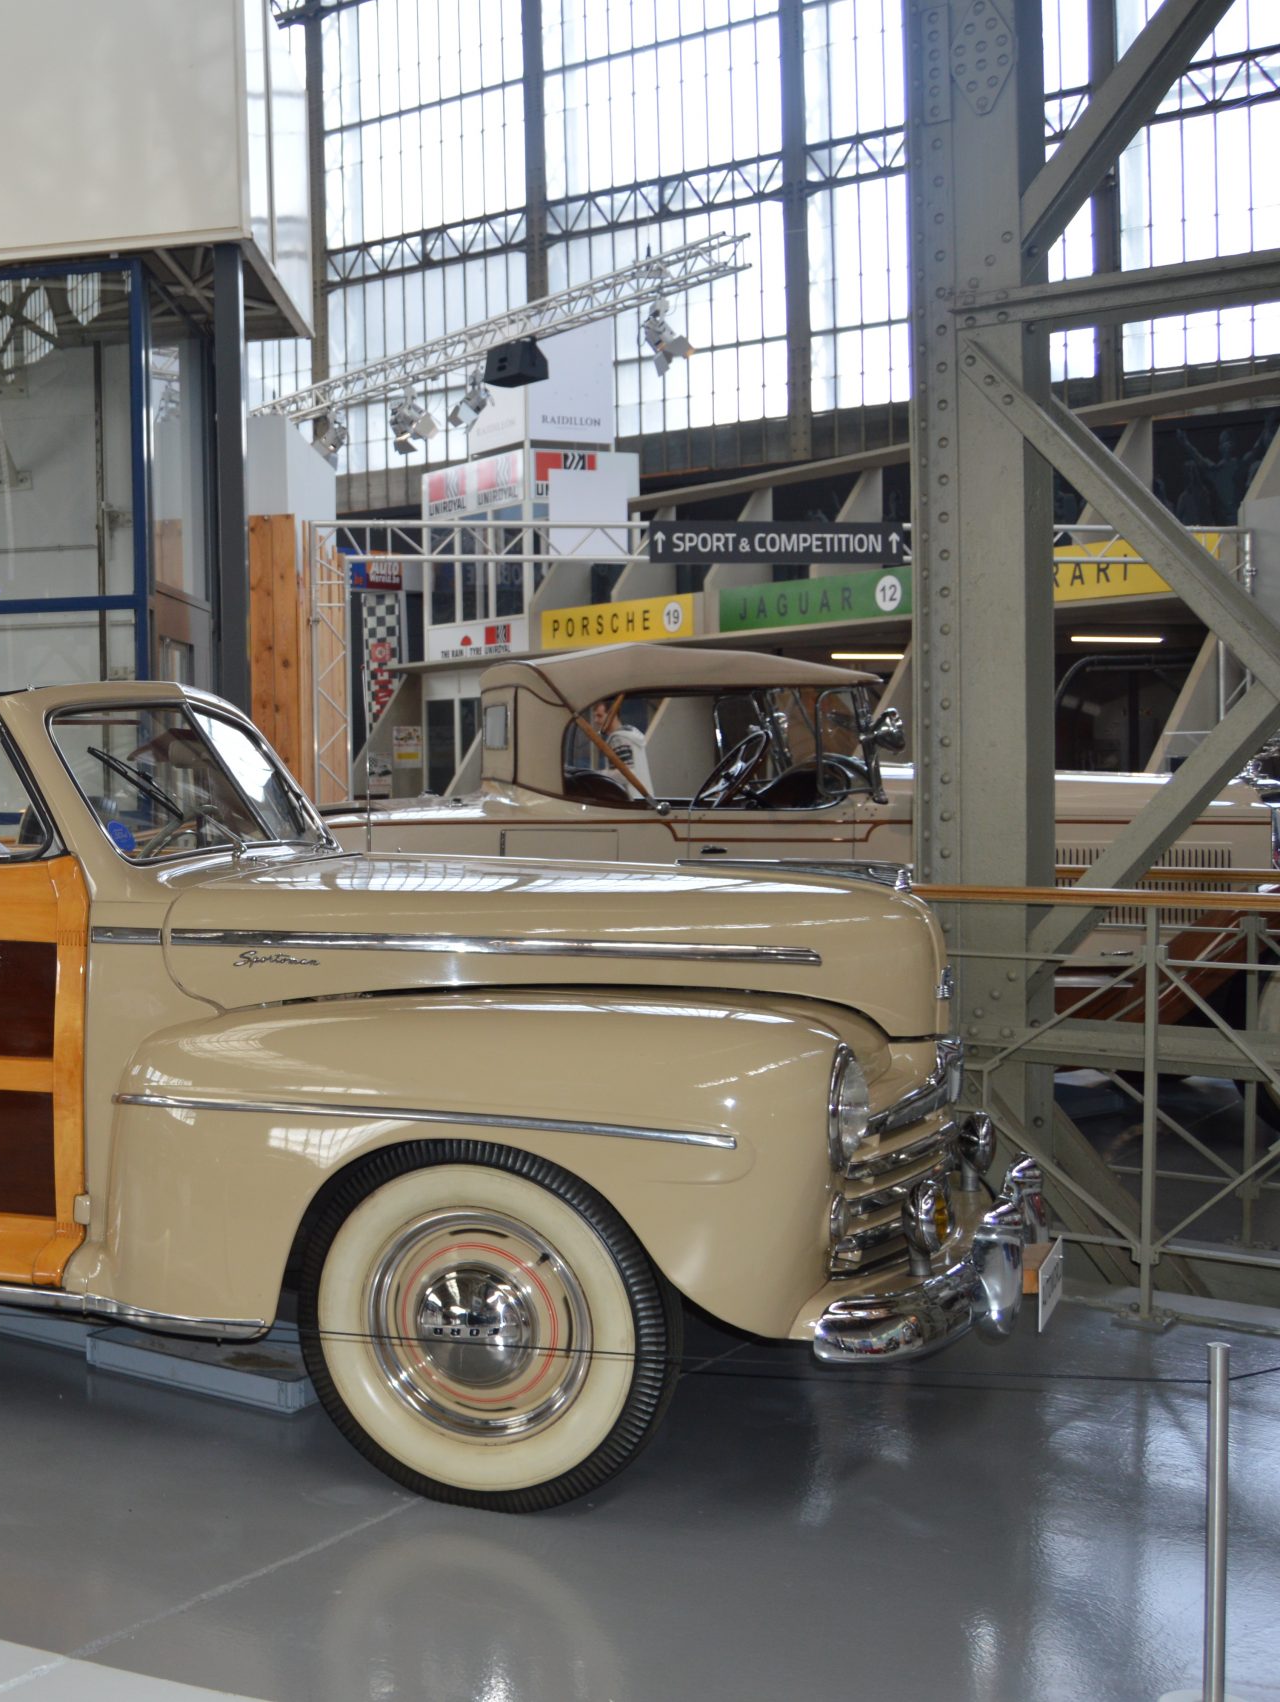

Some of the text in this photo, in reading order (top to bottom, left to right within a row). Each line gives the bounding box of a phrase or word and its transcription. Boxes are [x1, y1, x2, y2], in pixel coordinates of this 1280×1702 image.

[541, 414, 601, 427] RAIDILLON
[477, 485, 518, 505] UNIROYAL
[429, 498, 466, 516] UNIROYAL
[672, 532, 882, 553] SPORT & COMPETITION
[738, 584, 898, 620] JAGUAR 12
[552, 609, 680, 639] PORSCHE 19
[441, 644, 511, 659] THE RAIN TYRE UNIROYAL
